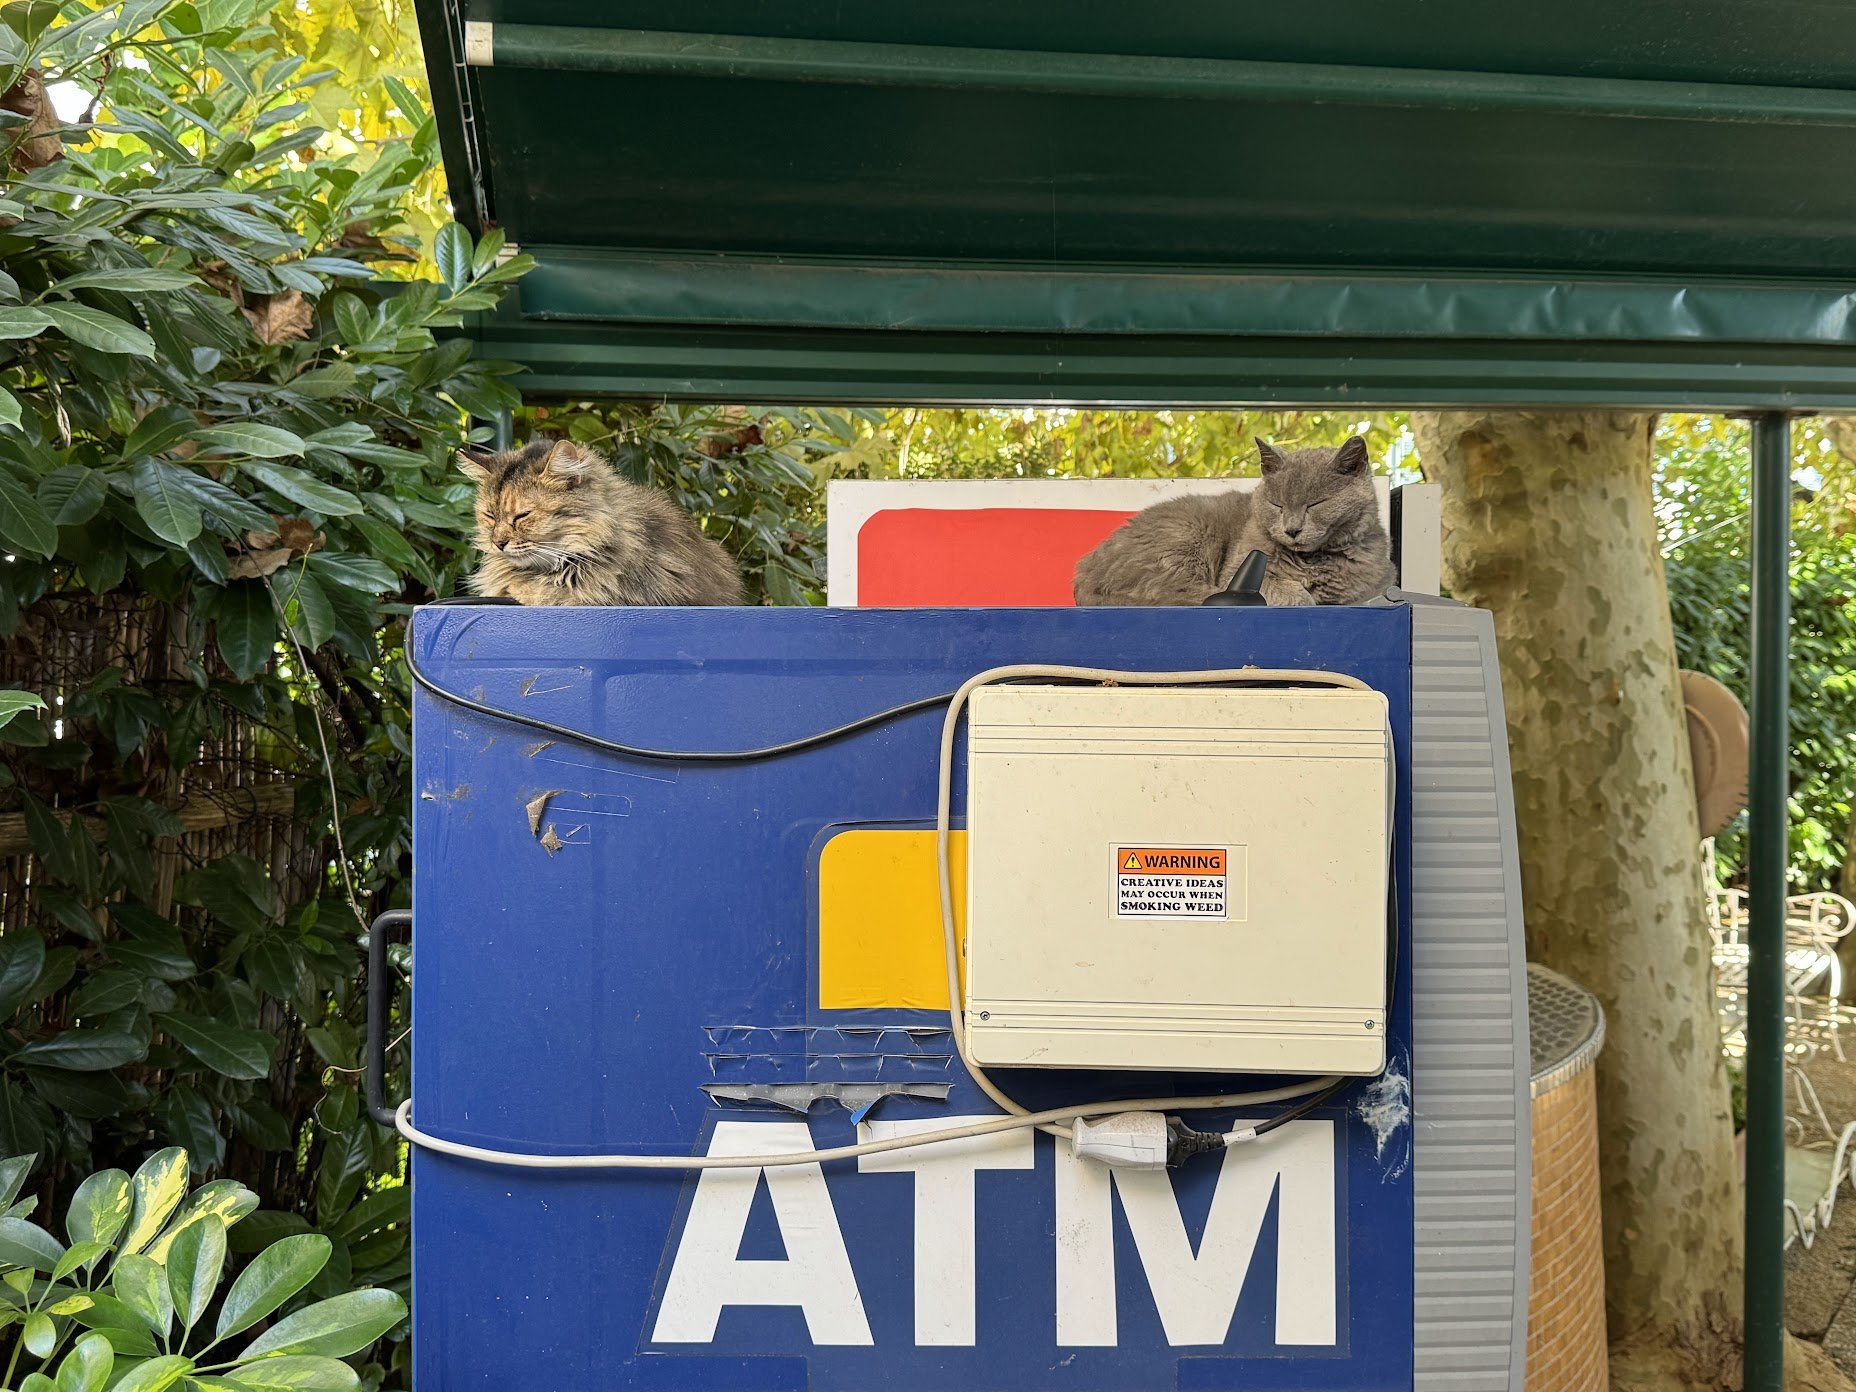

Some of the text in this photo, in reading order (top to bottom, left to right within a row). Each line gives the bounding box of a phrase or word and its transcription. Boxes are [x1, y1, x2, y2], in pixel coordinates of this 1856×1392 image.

[1144, 855, 1220, 869] WARNING
[1120, 878, 1224, 888] CREATIVE IDEAS
[1120, 890, 1223, 900] MAY OCCUR WHEN
[1120, 901, 1224, 912] SMOKING WEED
[651, 1115, 1336, 1346] ATM
